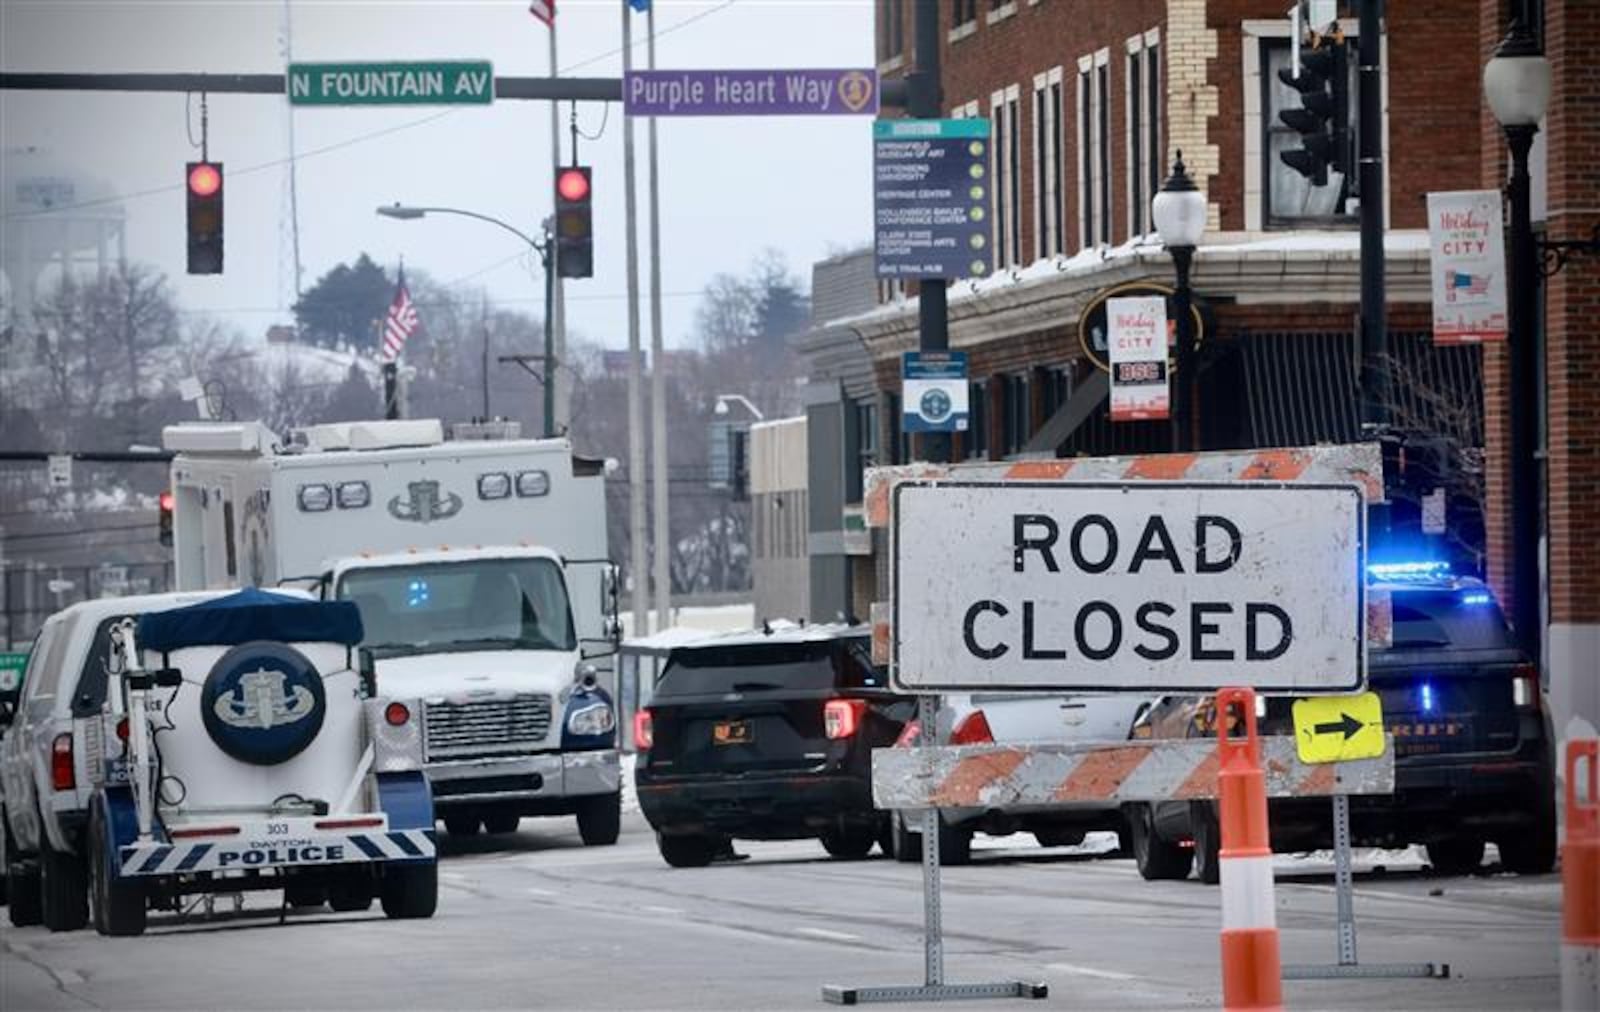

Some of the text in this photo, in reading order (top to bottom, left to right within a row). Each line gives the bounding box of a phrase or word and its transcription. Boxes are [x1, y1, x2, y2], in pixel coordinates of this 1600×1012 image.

[292, 71, 488, 97] N FOUNTAIN AV
[631, 75, 833, 111] Purple Heart Way
[928, 148, 945, 157] ART
[918, 189, 953, 199] CENTER
[933, 215, 967, 224] CENTER
[1440, 209, 1489, 236] Holiday
[1443, 240, 1486, 255] CITY
[1118, 337, 1153, 349] CITY
[1013, 513, 1243, 575] ROAD
[962, 599, 1294, 661] CLOSED
[267, 823, 289, 836] 303
[251, 839, 313, 849] DAYTON
[218, 845, 345, 867] POLICE
